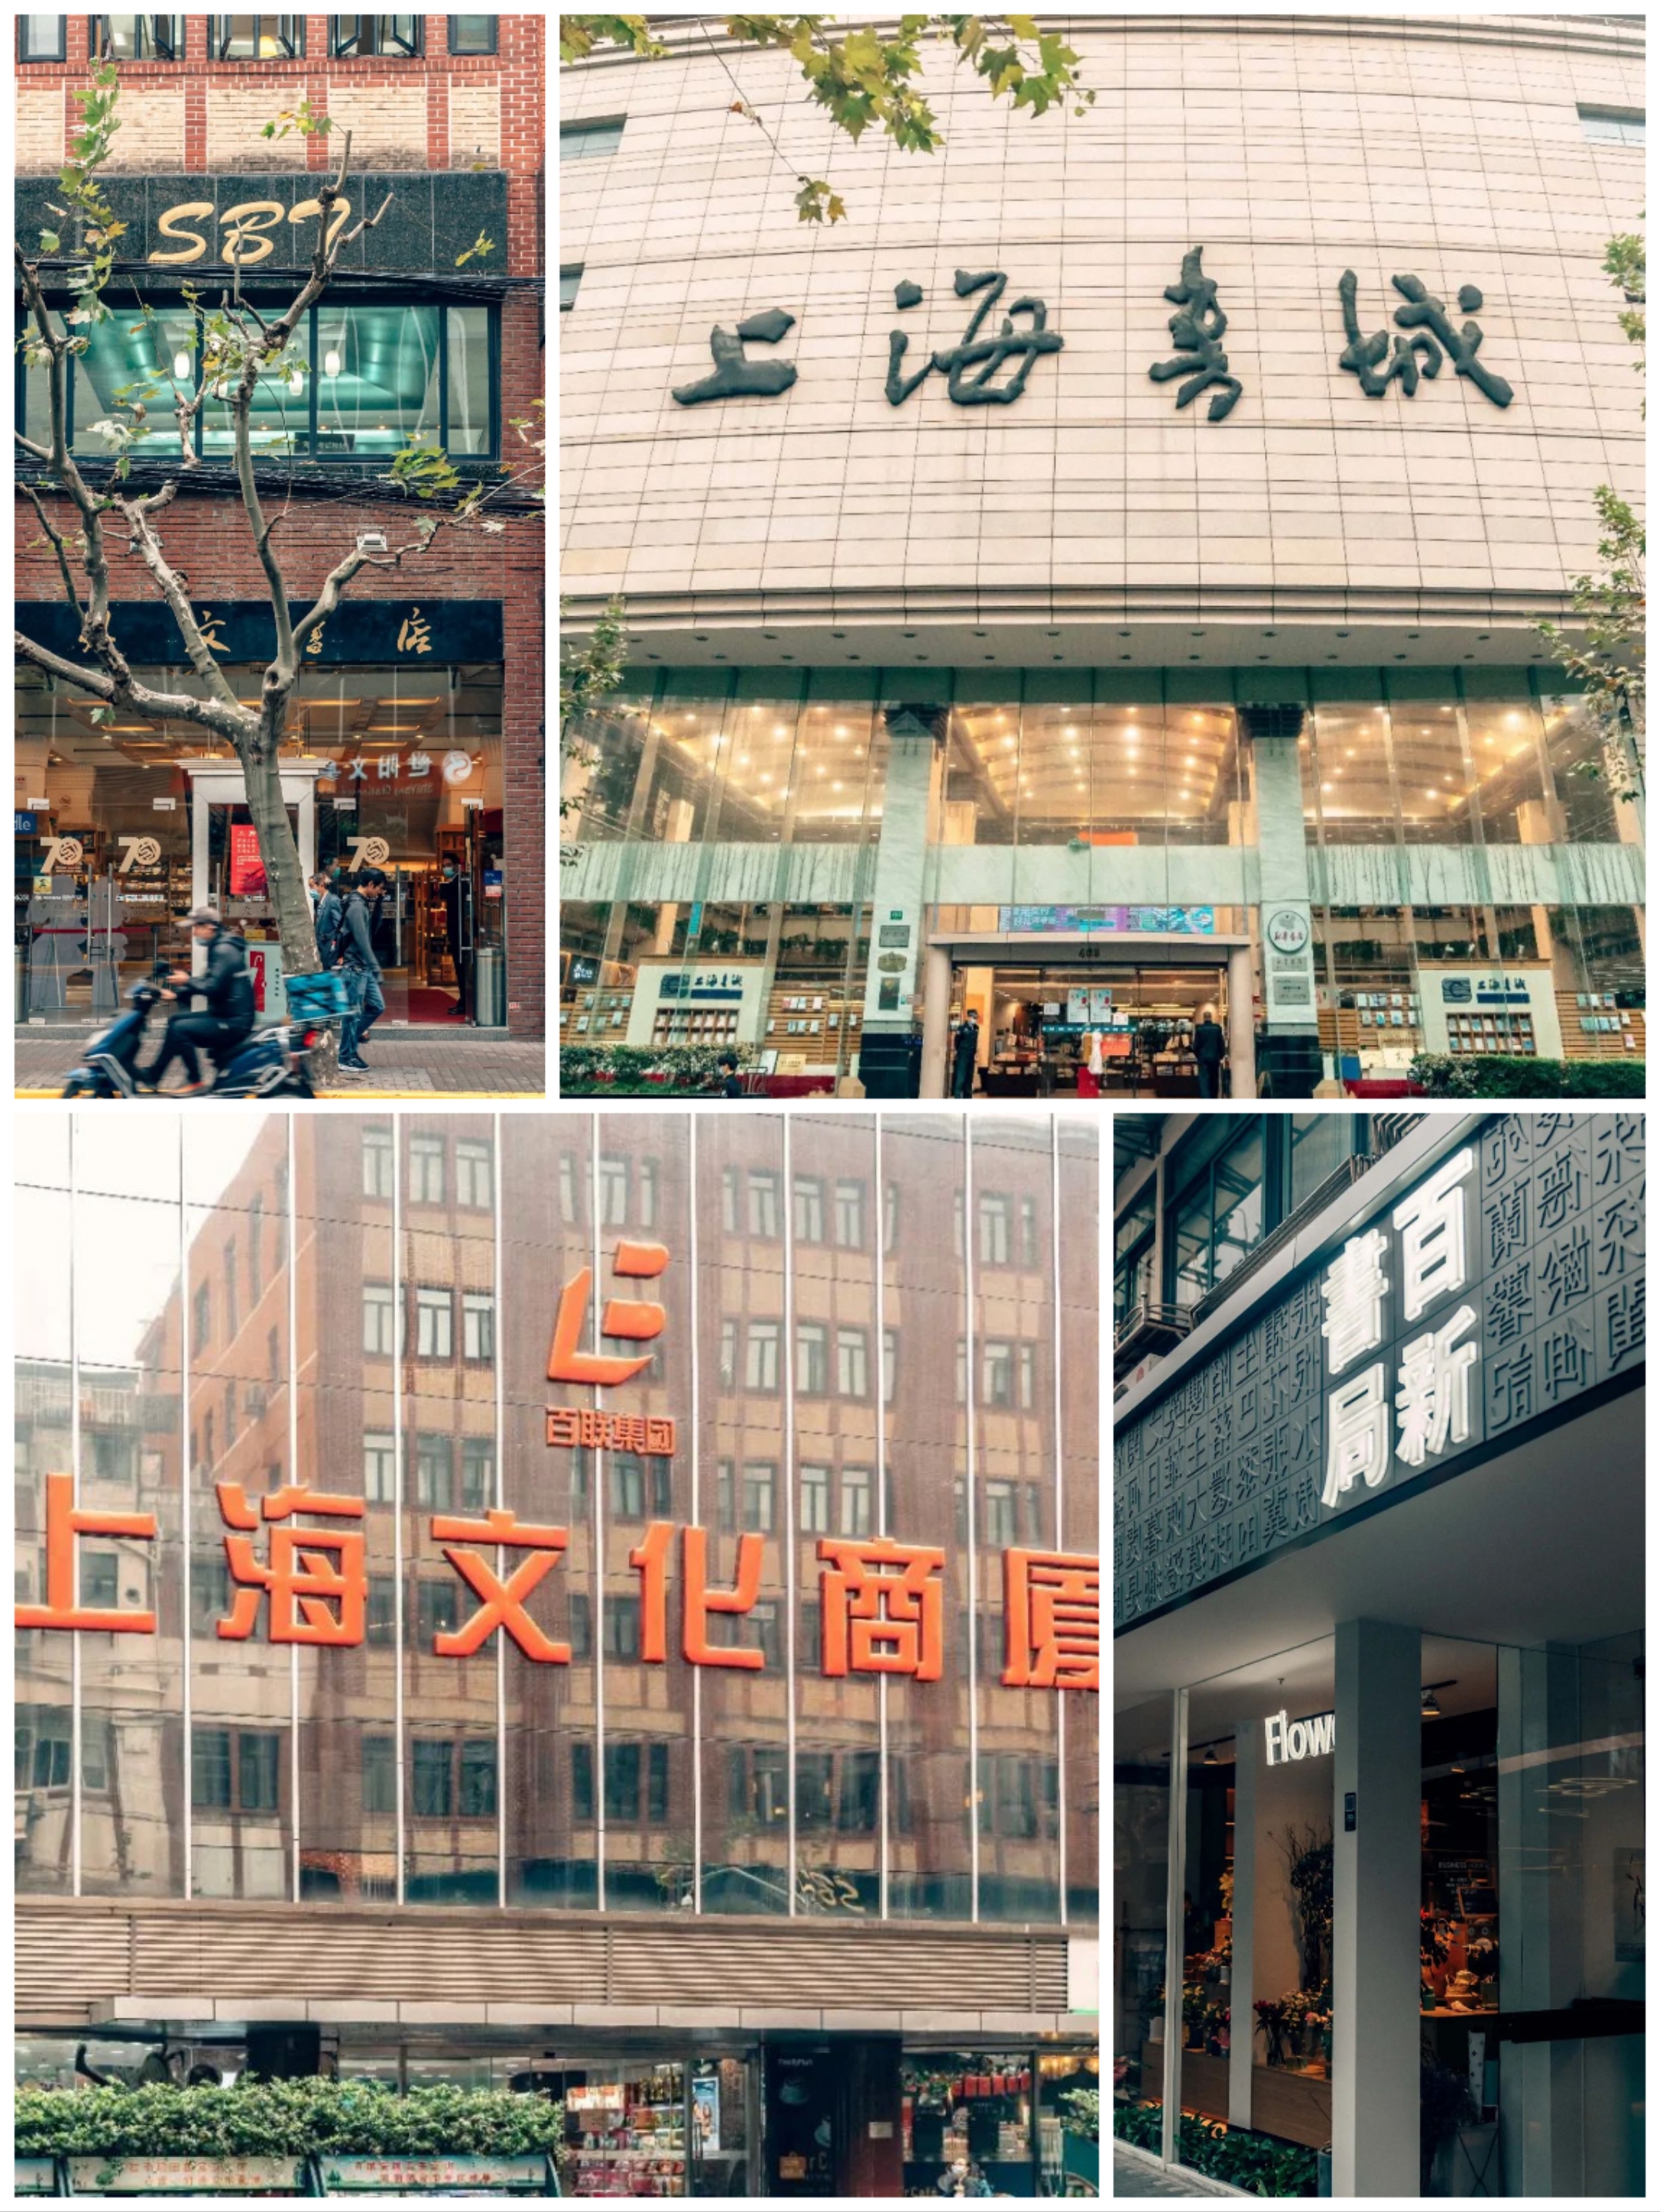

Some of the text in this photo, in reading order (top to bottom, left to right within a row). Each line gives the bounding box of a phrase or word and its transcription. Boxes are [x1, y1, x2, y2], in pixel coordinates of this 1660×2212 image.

[545, 1406, 676, 1454] 百联集团
[1265, 1710, 1335, 1766] Flow
